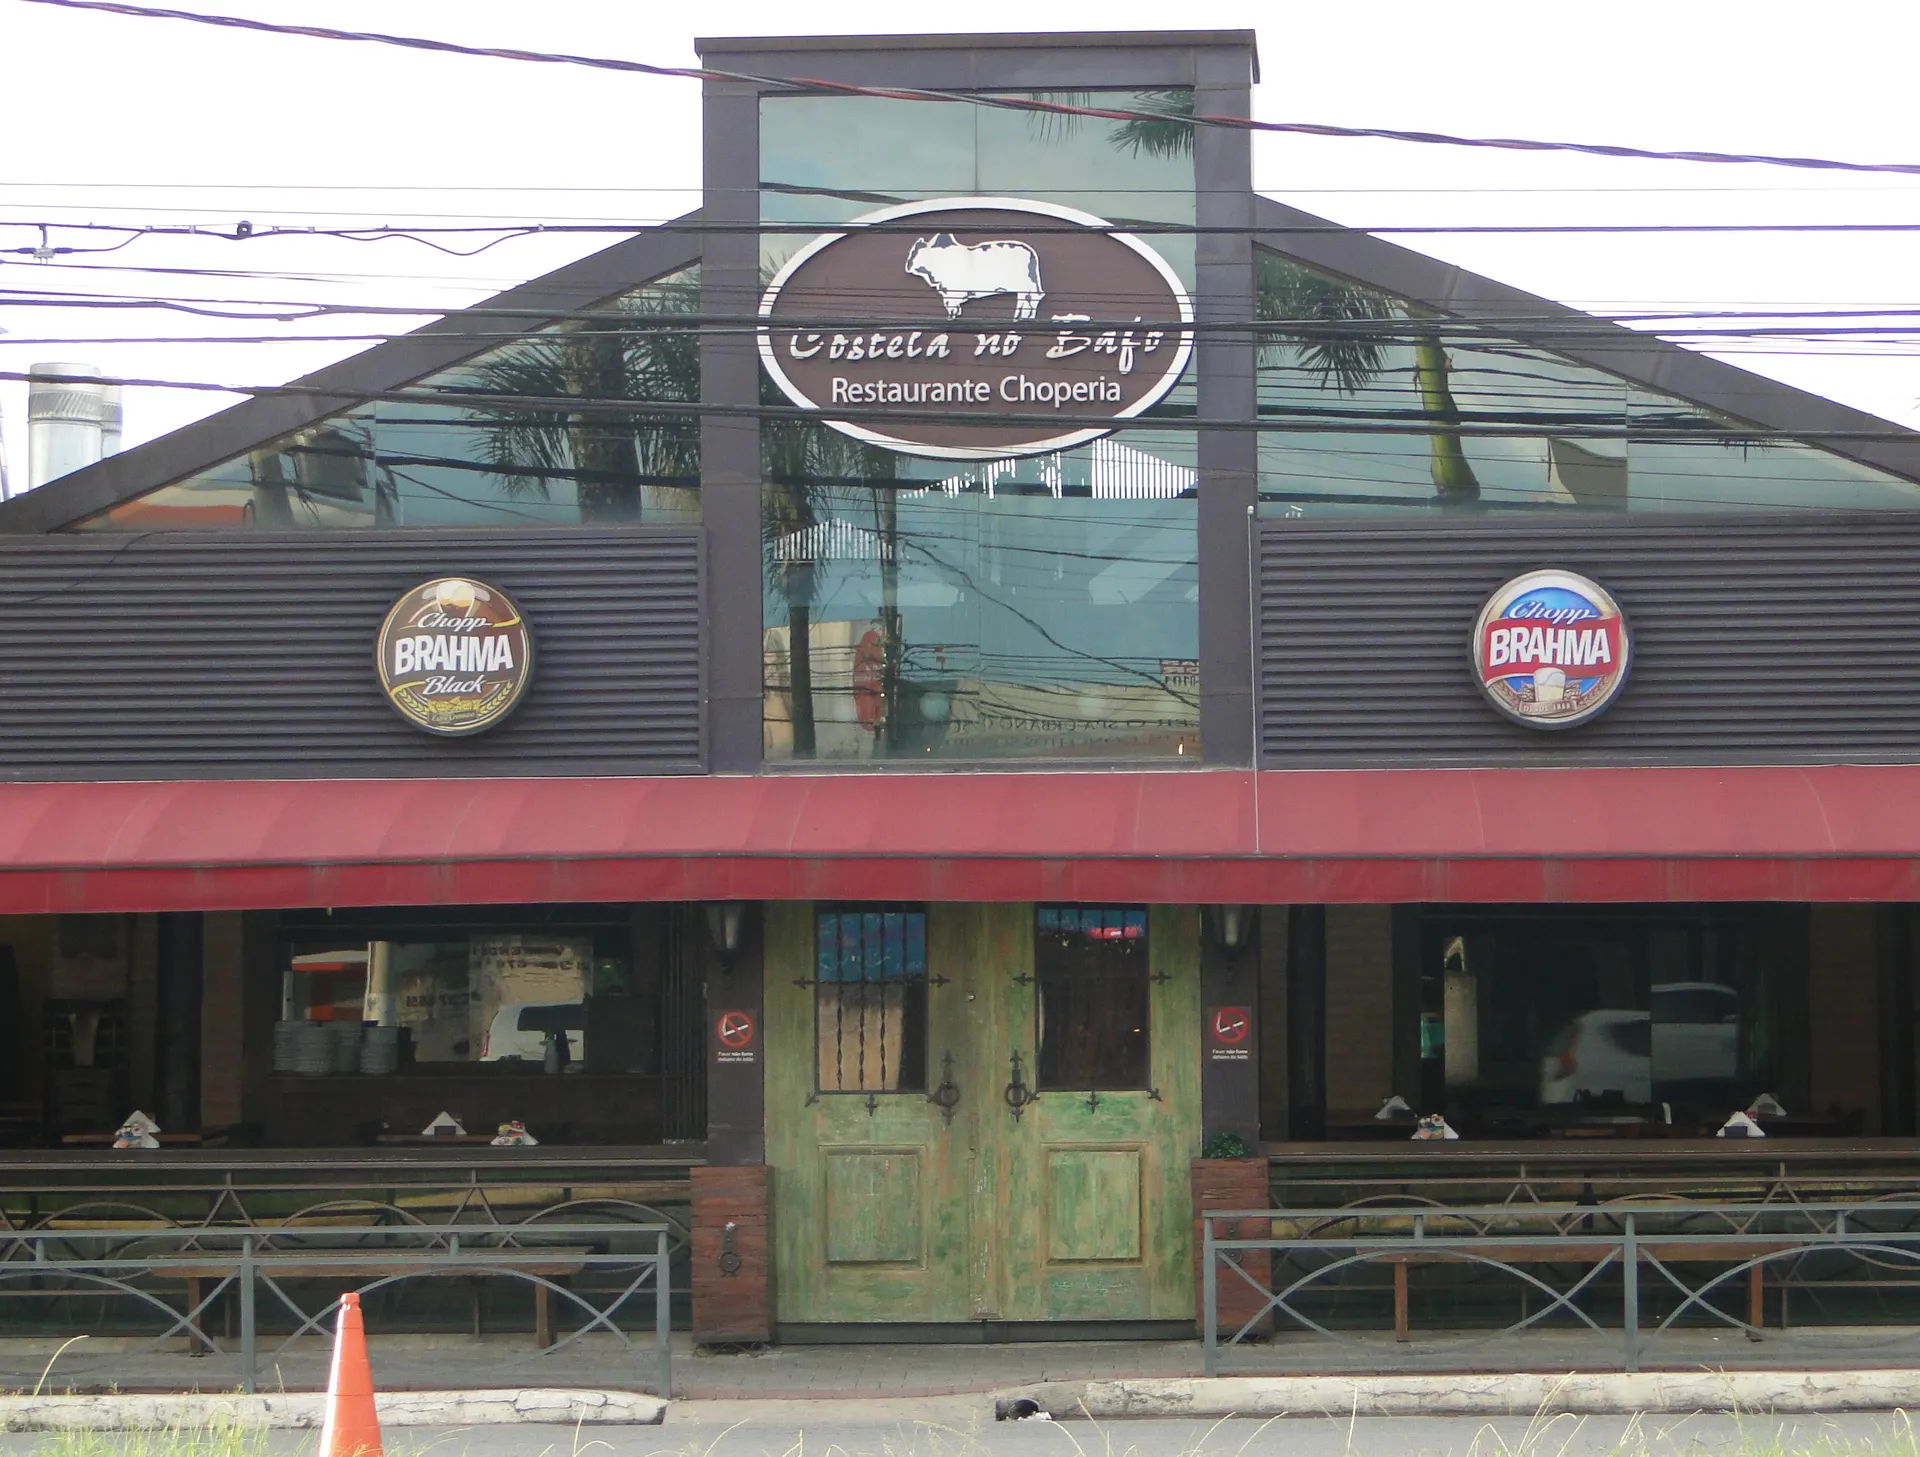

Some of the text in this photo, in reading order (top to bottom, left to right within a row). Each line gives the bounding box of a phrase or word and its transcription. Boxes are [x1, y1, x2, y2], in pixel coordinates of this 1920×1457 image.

[974, 331, 1022, 356] no
[832, 374, 1121, 408] Restaurante Choperia
[417, 612, 492, 632] Chopp
[1509, 601, 1598, 624] Chopp
[394, 634, 514, 676] BRAHMA
[1490, 626, 1611, 667] BRAHMA
[422, 674, 488, 695] Black
